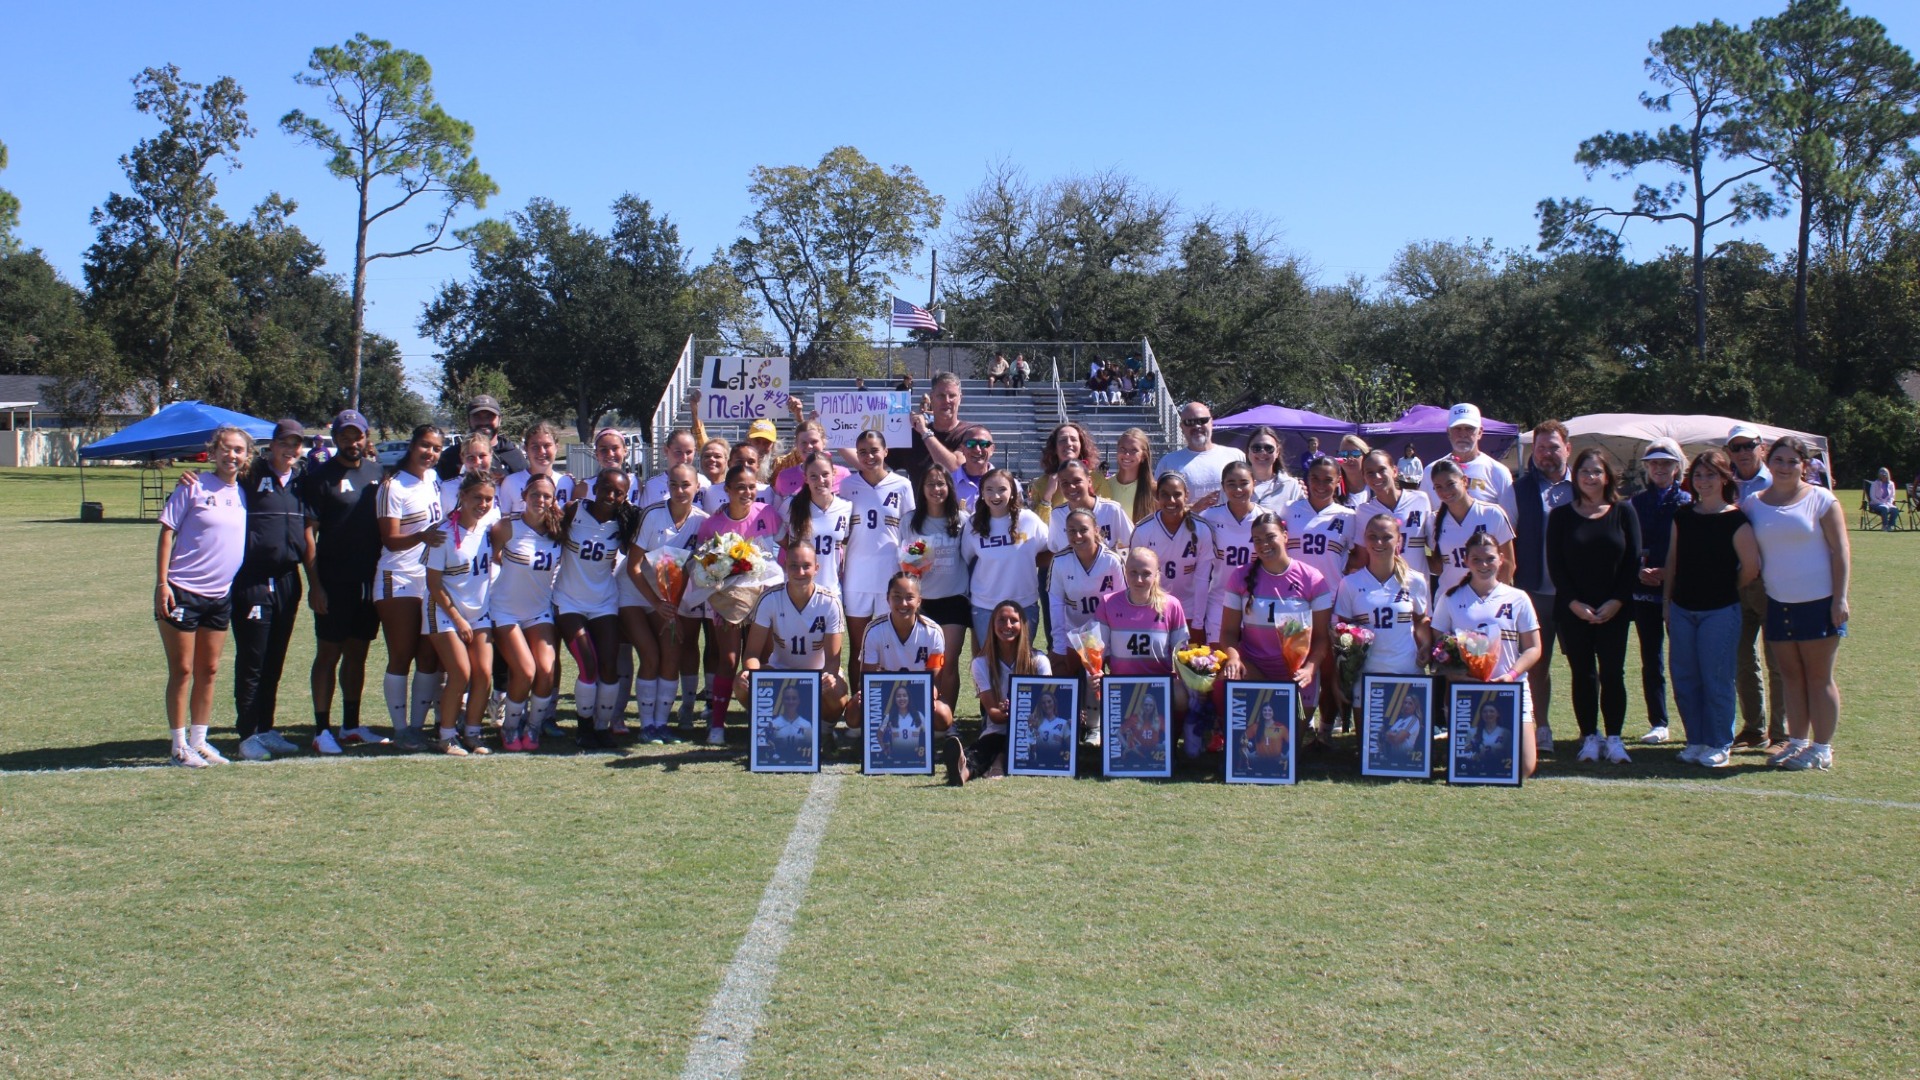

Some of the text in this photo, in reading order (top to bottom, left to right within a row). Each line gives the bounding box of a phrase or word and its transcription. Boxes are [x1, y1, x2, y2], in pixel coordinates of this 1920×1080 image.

[711, 358, 782, 390] Let's Go
[763, 389, 789, 408] #42
[831, 418, 858, 431] Since
[340, 478, 355, 493] A
[428, 502, 441, 523] 16
[867, 509, 878, 529] 9
[580, 540, 605, 561] 26
[814, 535, 833, 555] 13
[1302, 533, 1327, 555] 29
[472, 553, 490, 576] 14
[533, 551, 552, 572] 21
[1226, 546, 1250, 566] 20
[1165, 560, 1176, 579] 6
[1080, 596, 1100, 615] 10
[1267, 601, 1276, 623] 1
[1373, 607, 1394, 630] 12
[791, 636, 807, 655] 11
[1127, 633, 1151, 656] 42
[1232, 697, 1247, 731] MAY
[902, 728, 908, 740] 8
[1043, 730, 1050, 742] 3
[1142, 730, 1153, 740] 42
